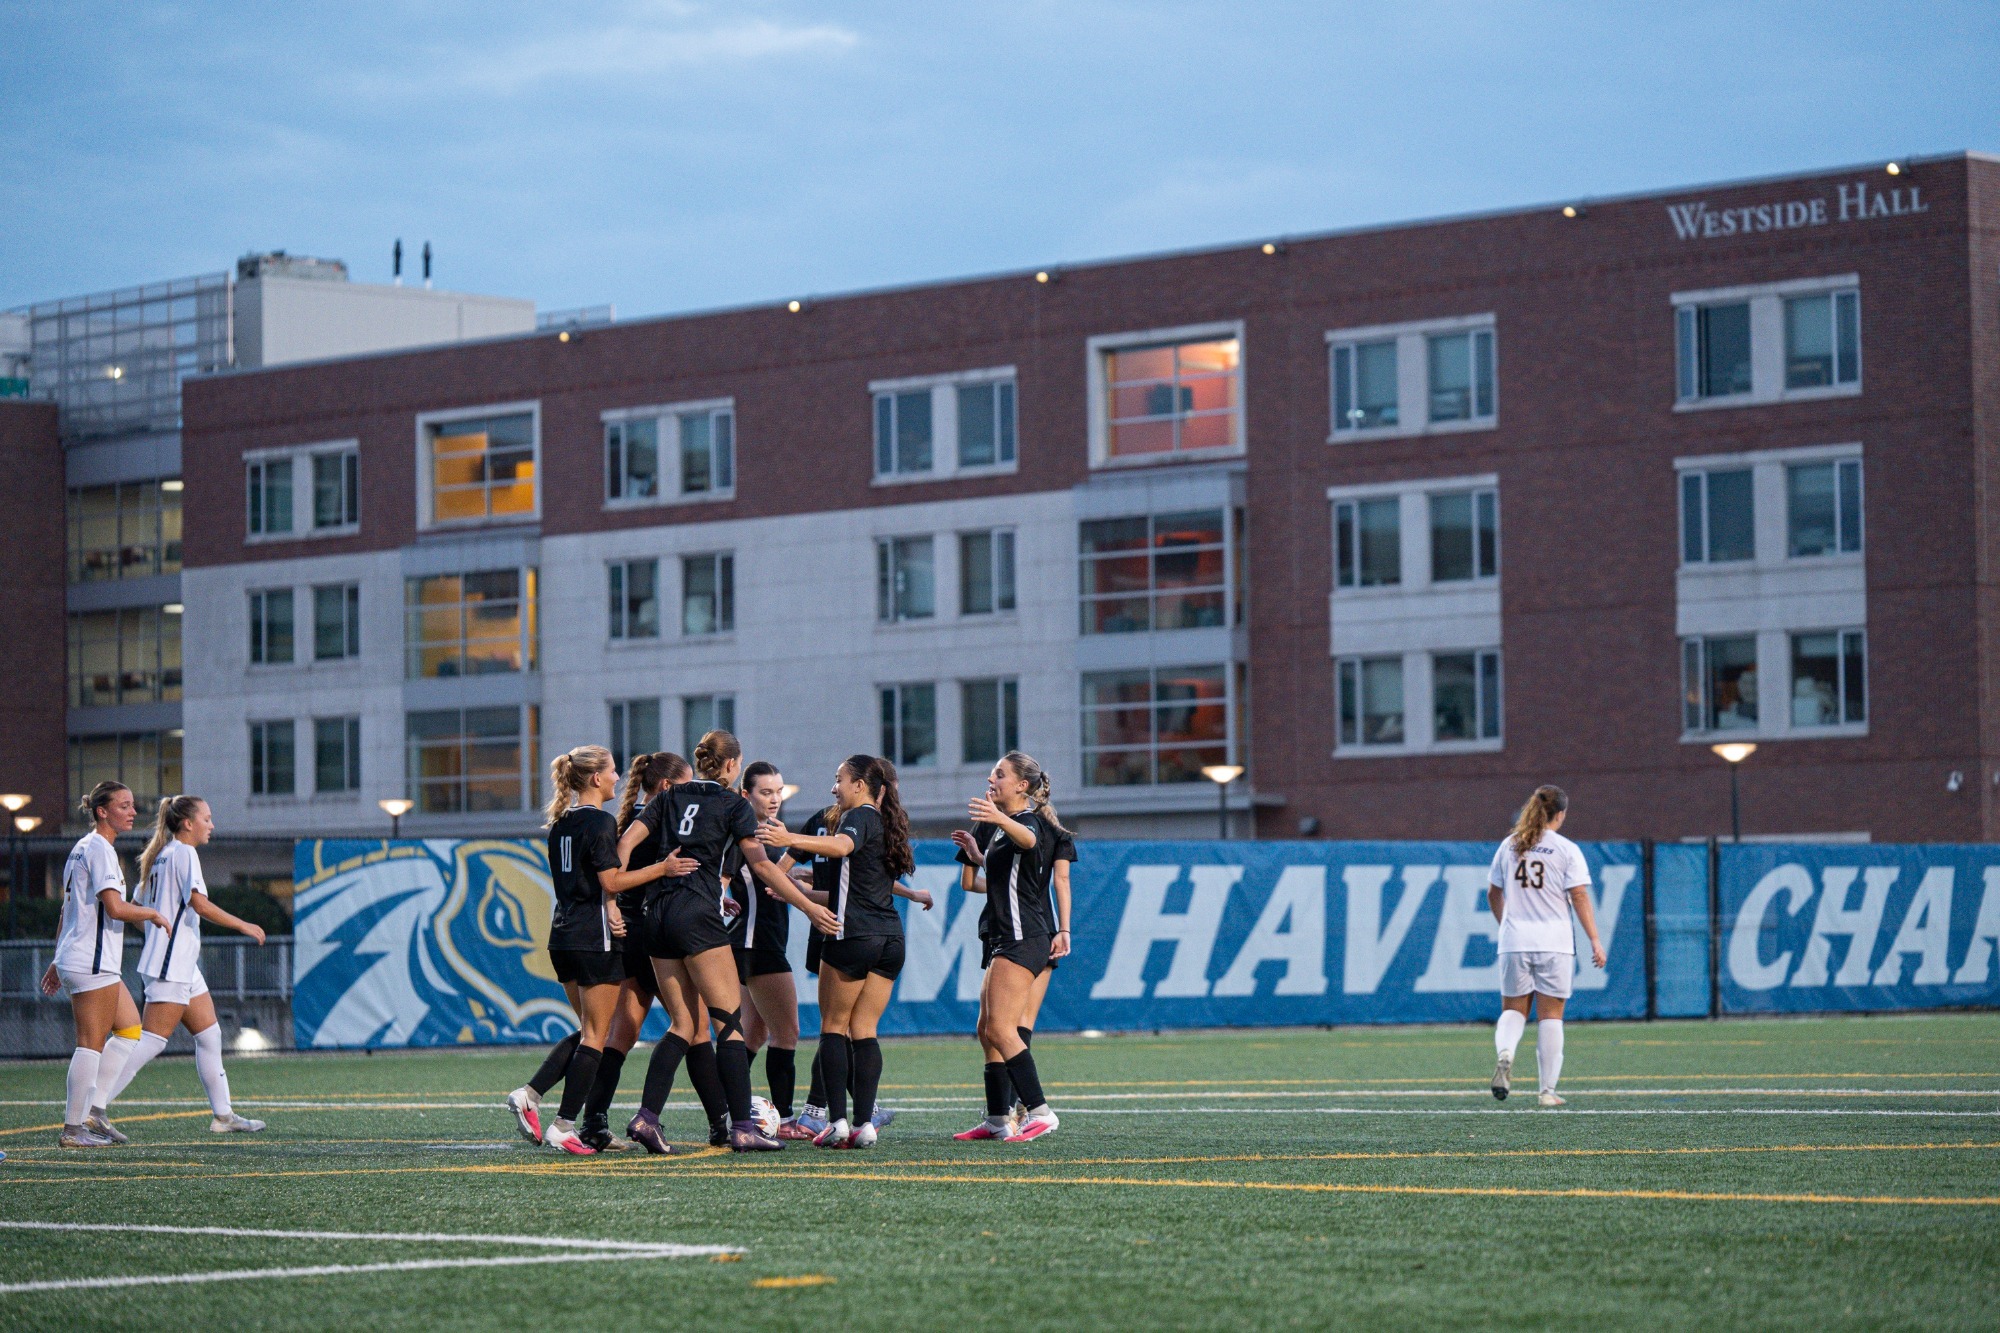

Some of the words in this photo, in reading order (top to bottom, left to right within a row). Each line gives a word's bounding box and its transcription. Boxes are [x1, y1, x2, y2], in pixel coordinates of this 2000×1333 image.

[1666, 198, 1828, 241] WESTSIDE
[1838, 182, 1929, 223] HALL
[678, 803, 700, 836] 8
[559, 835, 572, 873] 10
[1514, 860, 1544, 889] 43
